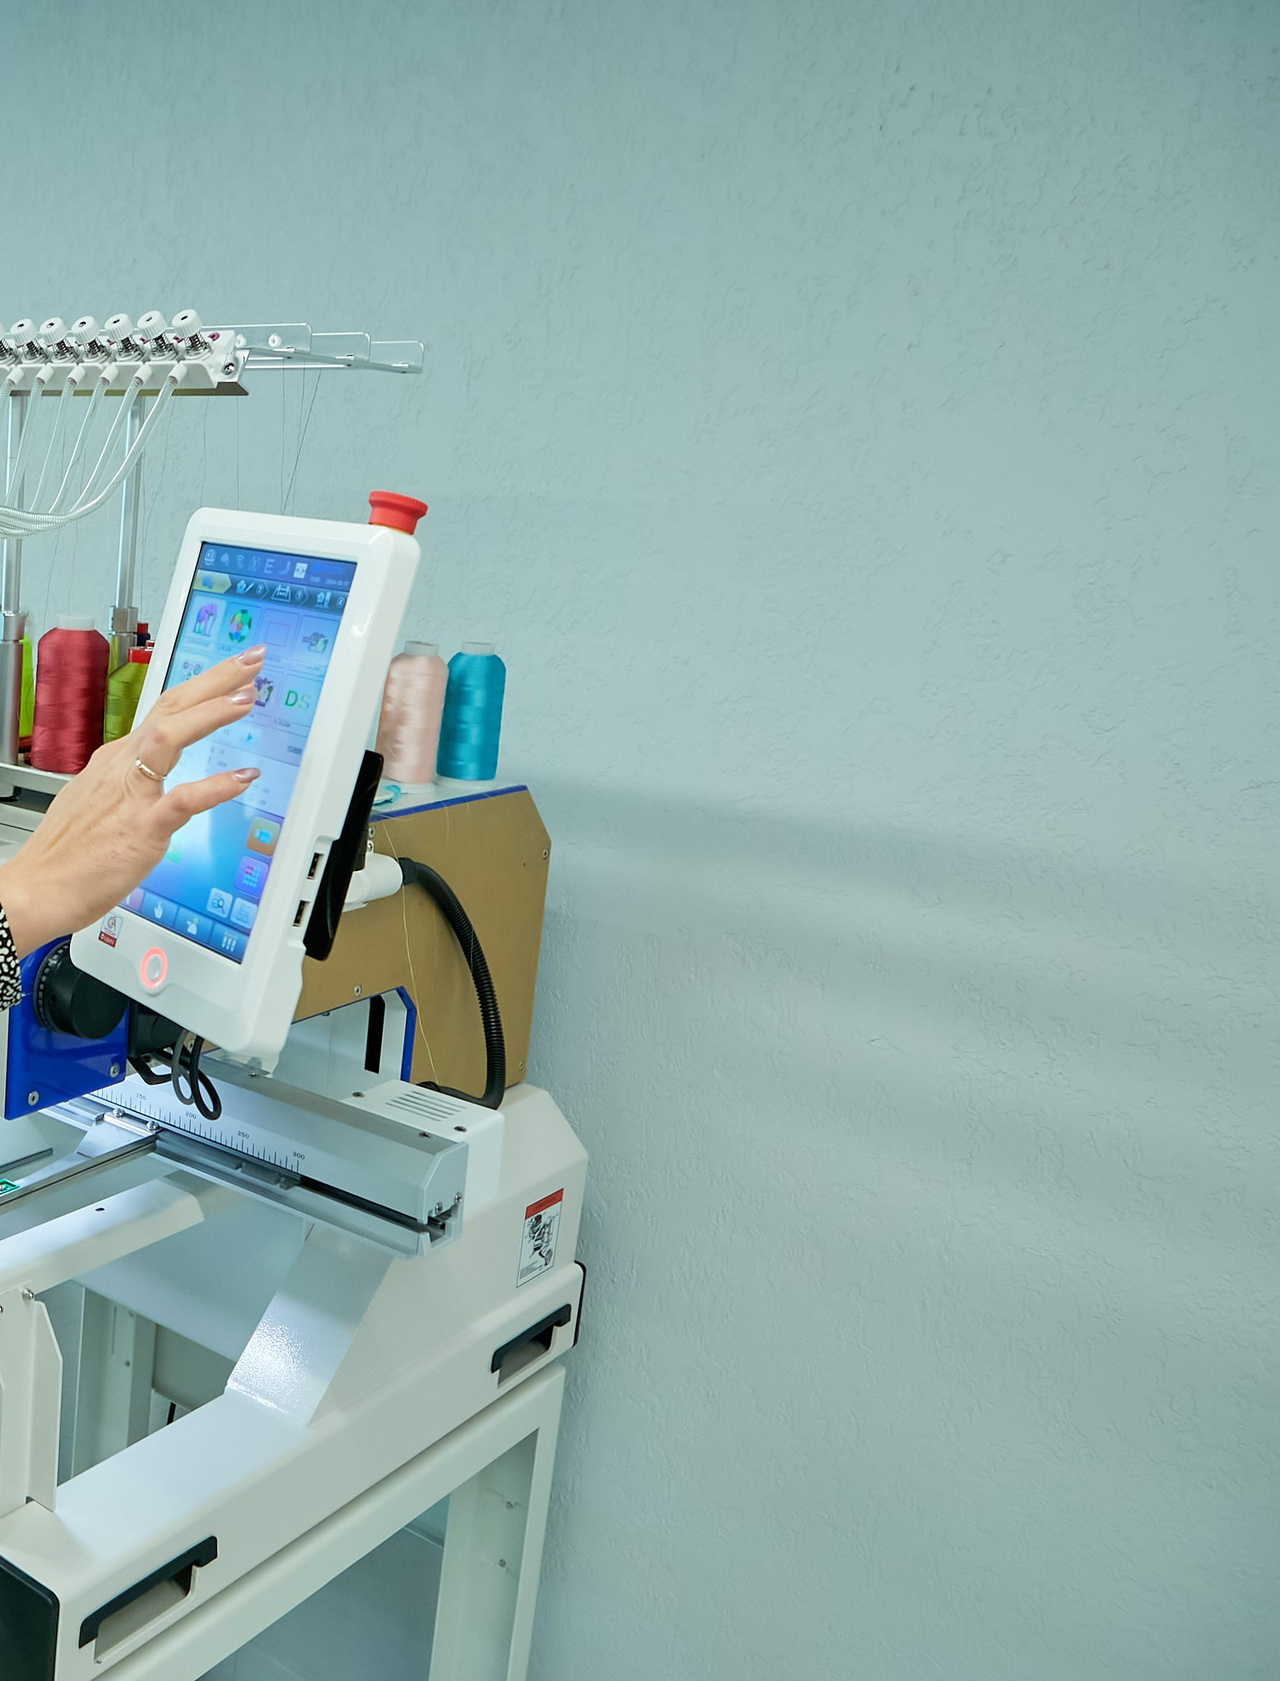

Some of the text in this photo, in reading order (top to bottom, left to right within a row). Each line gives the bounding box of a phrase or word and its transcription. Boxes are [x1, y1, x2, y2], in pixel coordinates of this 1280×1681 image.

[284, 690, 311, 710] DS
[136, 1093, 306, 1160] 150 200 250 300
